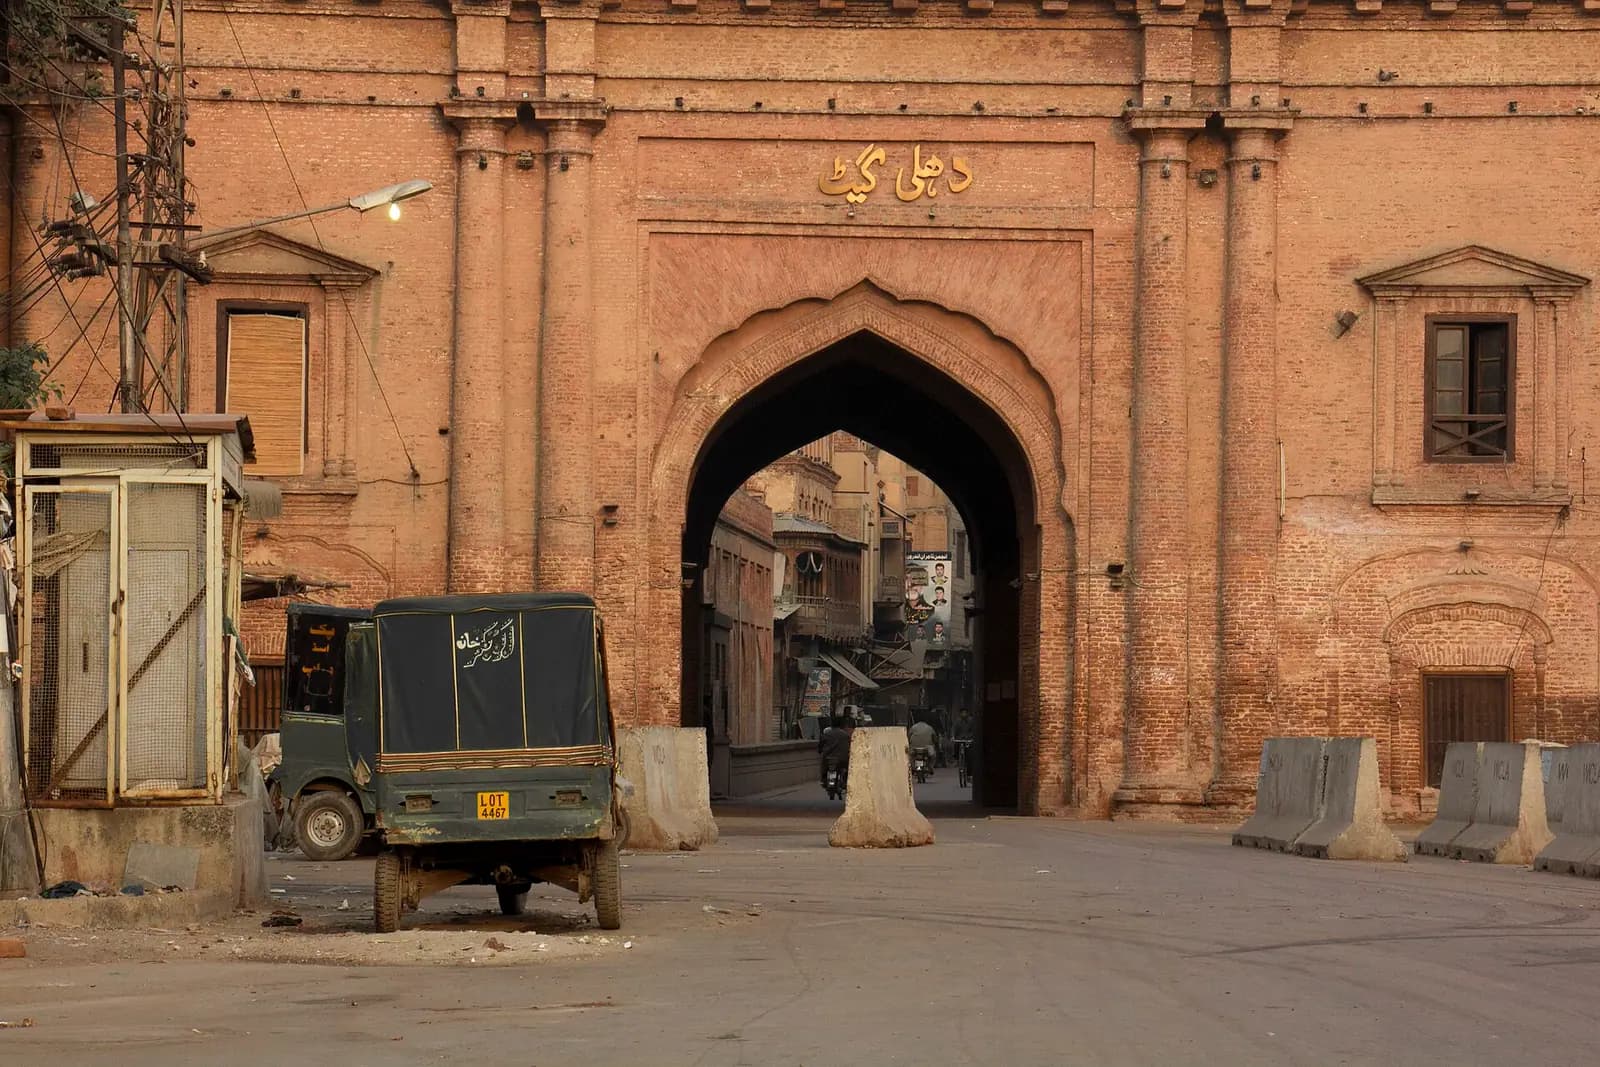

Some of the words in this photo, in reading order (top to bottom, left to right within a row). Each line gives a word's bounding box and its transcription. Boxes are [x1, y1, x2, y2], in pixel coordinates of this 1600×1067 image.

[818, 143, 886, 203] گیٹ
[480, 794, 504, 807] LOT
[482, 808, 506, 818] 4467
